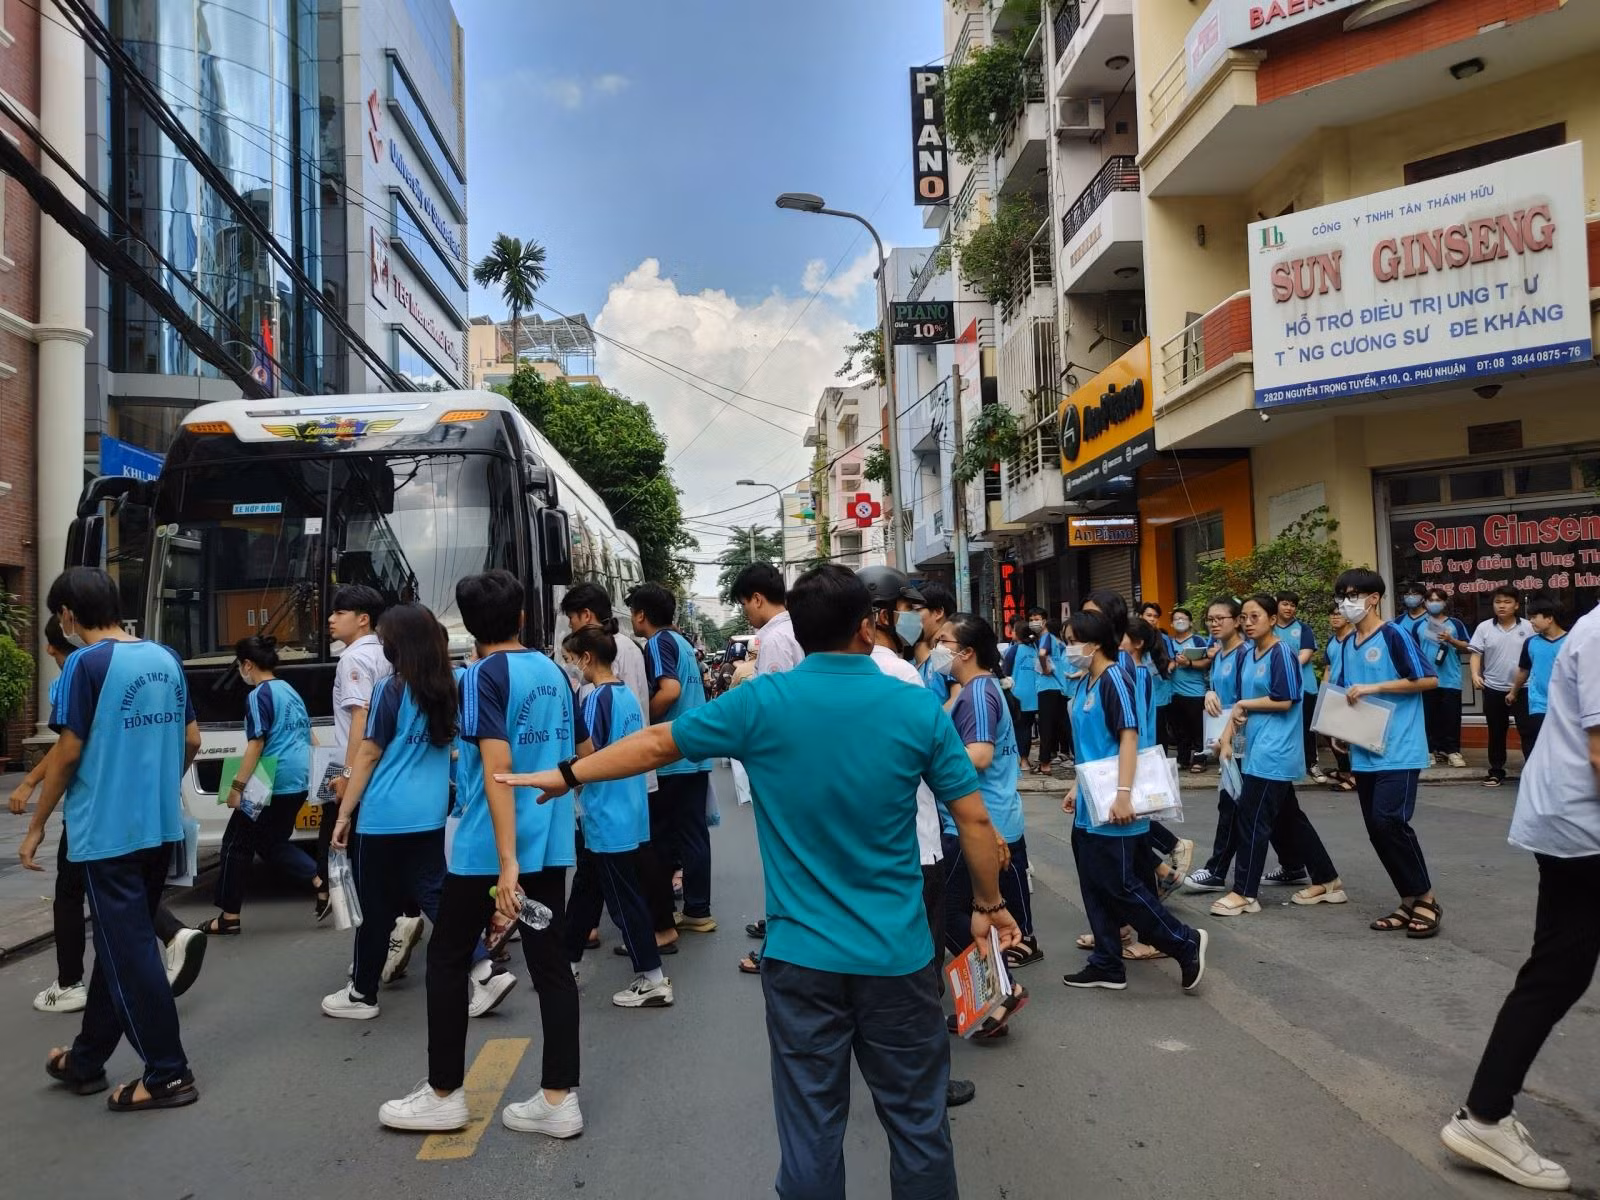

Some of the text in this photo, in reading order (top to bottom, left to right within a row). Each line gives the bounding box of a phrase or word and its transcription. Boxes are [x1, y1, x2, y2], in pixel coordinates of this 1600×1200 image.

[916, 72, 944, 199] PIANO
[1312, 222, 1341, 236] CÔNG
[1365, 209, 1394, 223] TNHH
[1399, 203, 1422, 216] TÂN
[1427, 191, 1466, 210] THÁNH
[1271, 204, 1556, 303] SUN GINSENG
[896, 304, 949, 320] PIANO
[1286, 312, 1311, 338] HỖ
[1410, 295, 1442, 315] TRỊ
[1447, 287, 1490, 308] UNG
[1484, 303, 1564, 333] KHÁNG
[913, 323, 943, 338] 10%
[1264, 390, 1284, 402] 282D
[1285, 383, 1318, 400] NGUYỄN
[1320, 381, 1347, 396] TRỌNG
[1403, 373, 1412, 382] Q.
[1415, 366, 1433, 380] PHÚ
[1434, 363, 1466, 377] NHUẬN
[235, 505, 244, 513] XE
[1414, 514, 1600, 552] Sun Ginsen
[1422, 557, 1443, 574] Hỗ
[1447, 557, 1473, 574] trợ
[1477, 553, 1512, 571] điều
[1516, 552, 1537, 570] trị
[1540, 551, 1575, 567] Ung
[1513, 575, 1543, 590] sức
[1548, 571, 1570, 588] đề
[146, 672, 169, 684] THCS
[537, 685, 557, 697] THCS
[517, 725, 550, 745] HỒNG
